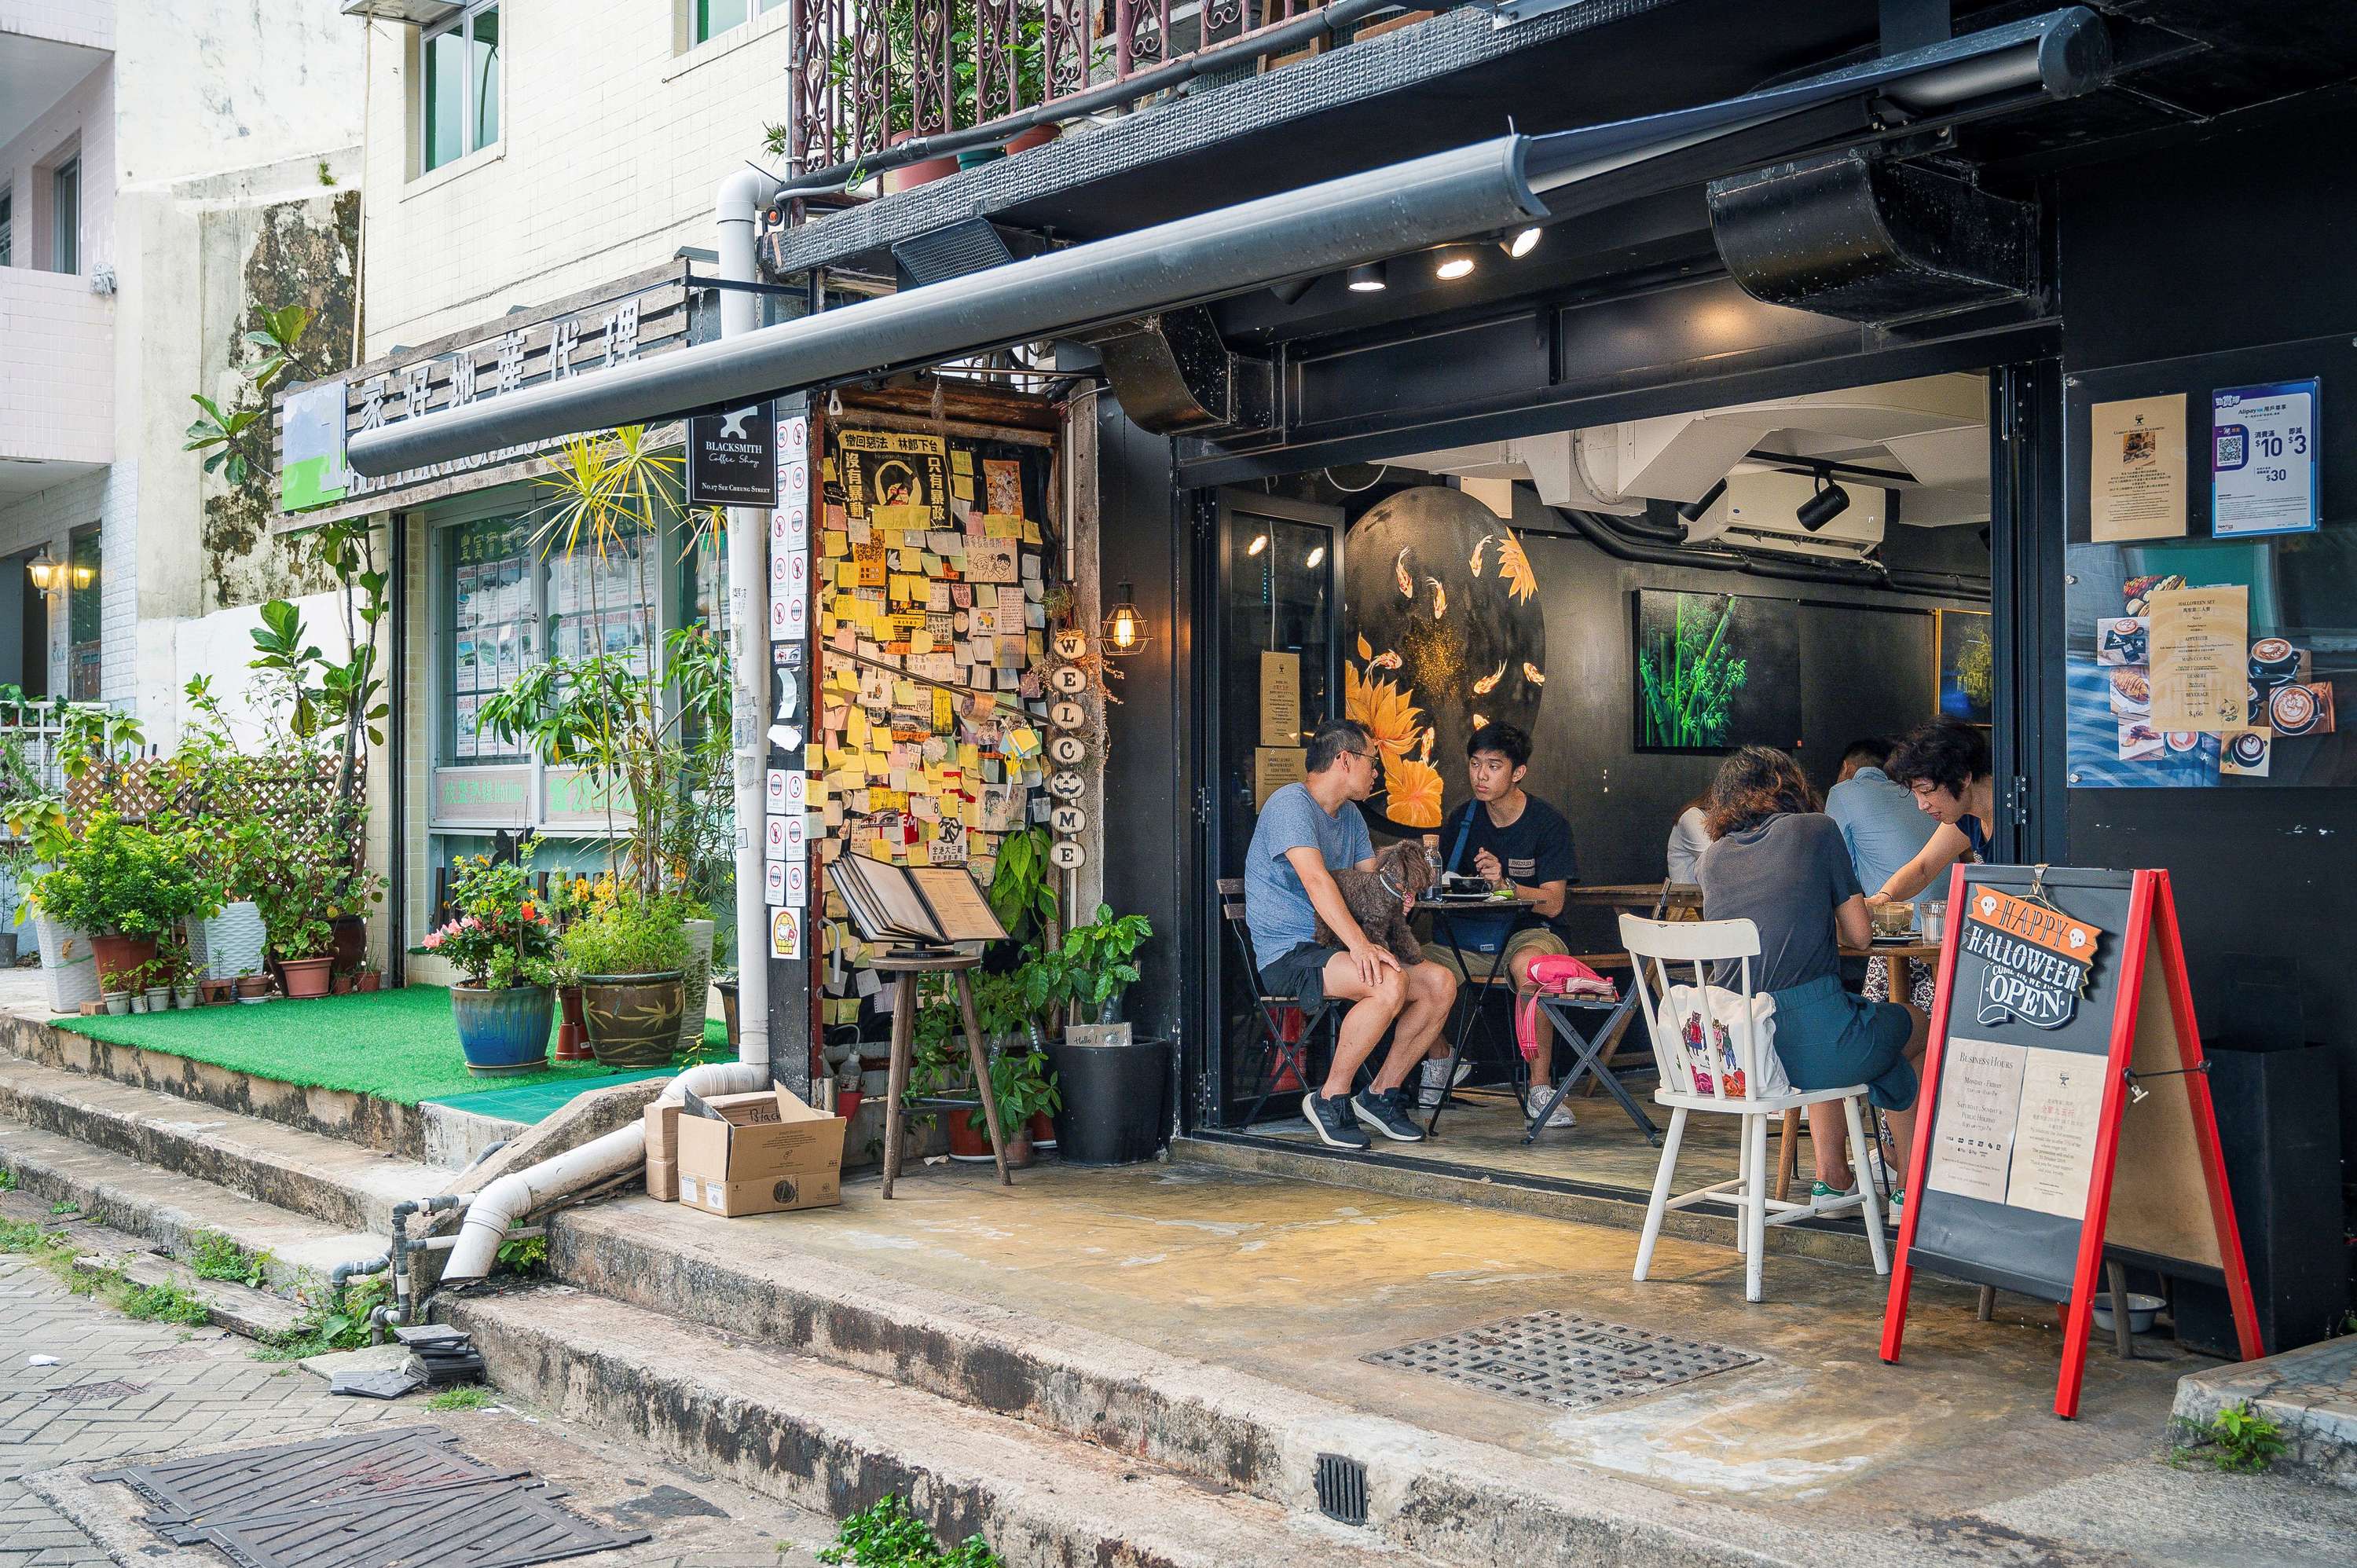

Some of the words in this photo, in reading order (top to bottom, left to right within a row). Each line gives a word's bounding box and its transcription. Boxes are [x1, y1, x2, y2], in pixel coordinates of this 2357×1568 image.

[706, 441, 763, 455] BLACKSMITH
[898, 438, 938, 453] 林鄭下台
[2255, 437, 2282, 457] $10
[2288, 435, 2307, 455] $3
[709, 452, 735, 465] Coffee
[739, 453, 760, 468] Shop
[2266, 468, 2286, 482] $30
[845, 452, 864, 519] 沒有暴動
[927, 456, 946, 522] 只有暴政
[1999, 899, 2068, 947] HAPPY
[1989, 975, 2063, 1018] OPEN
